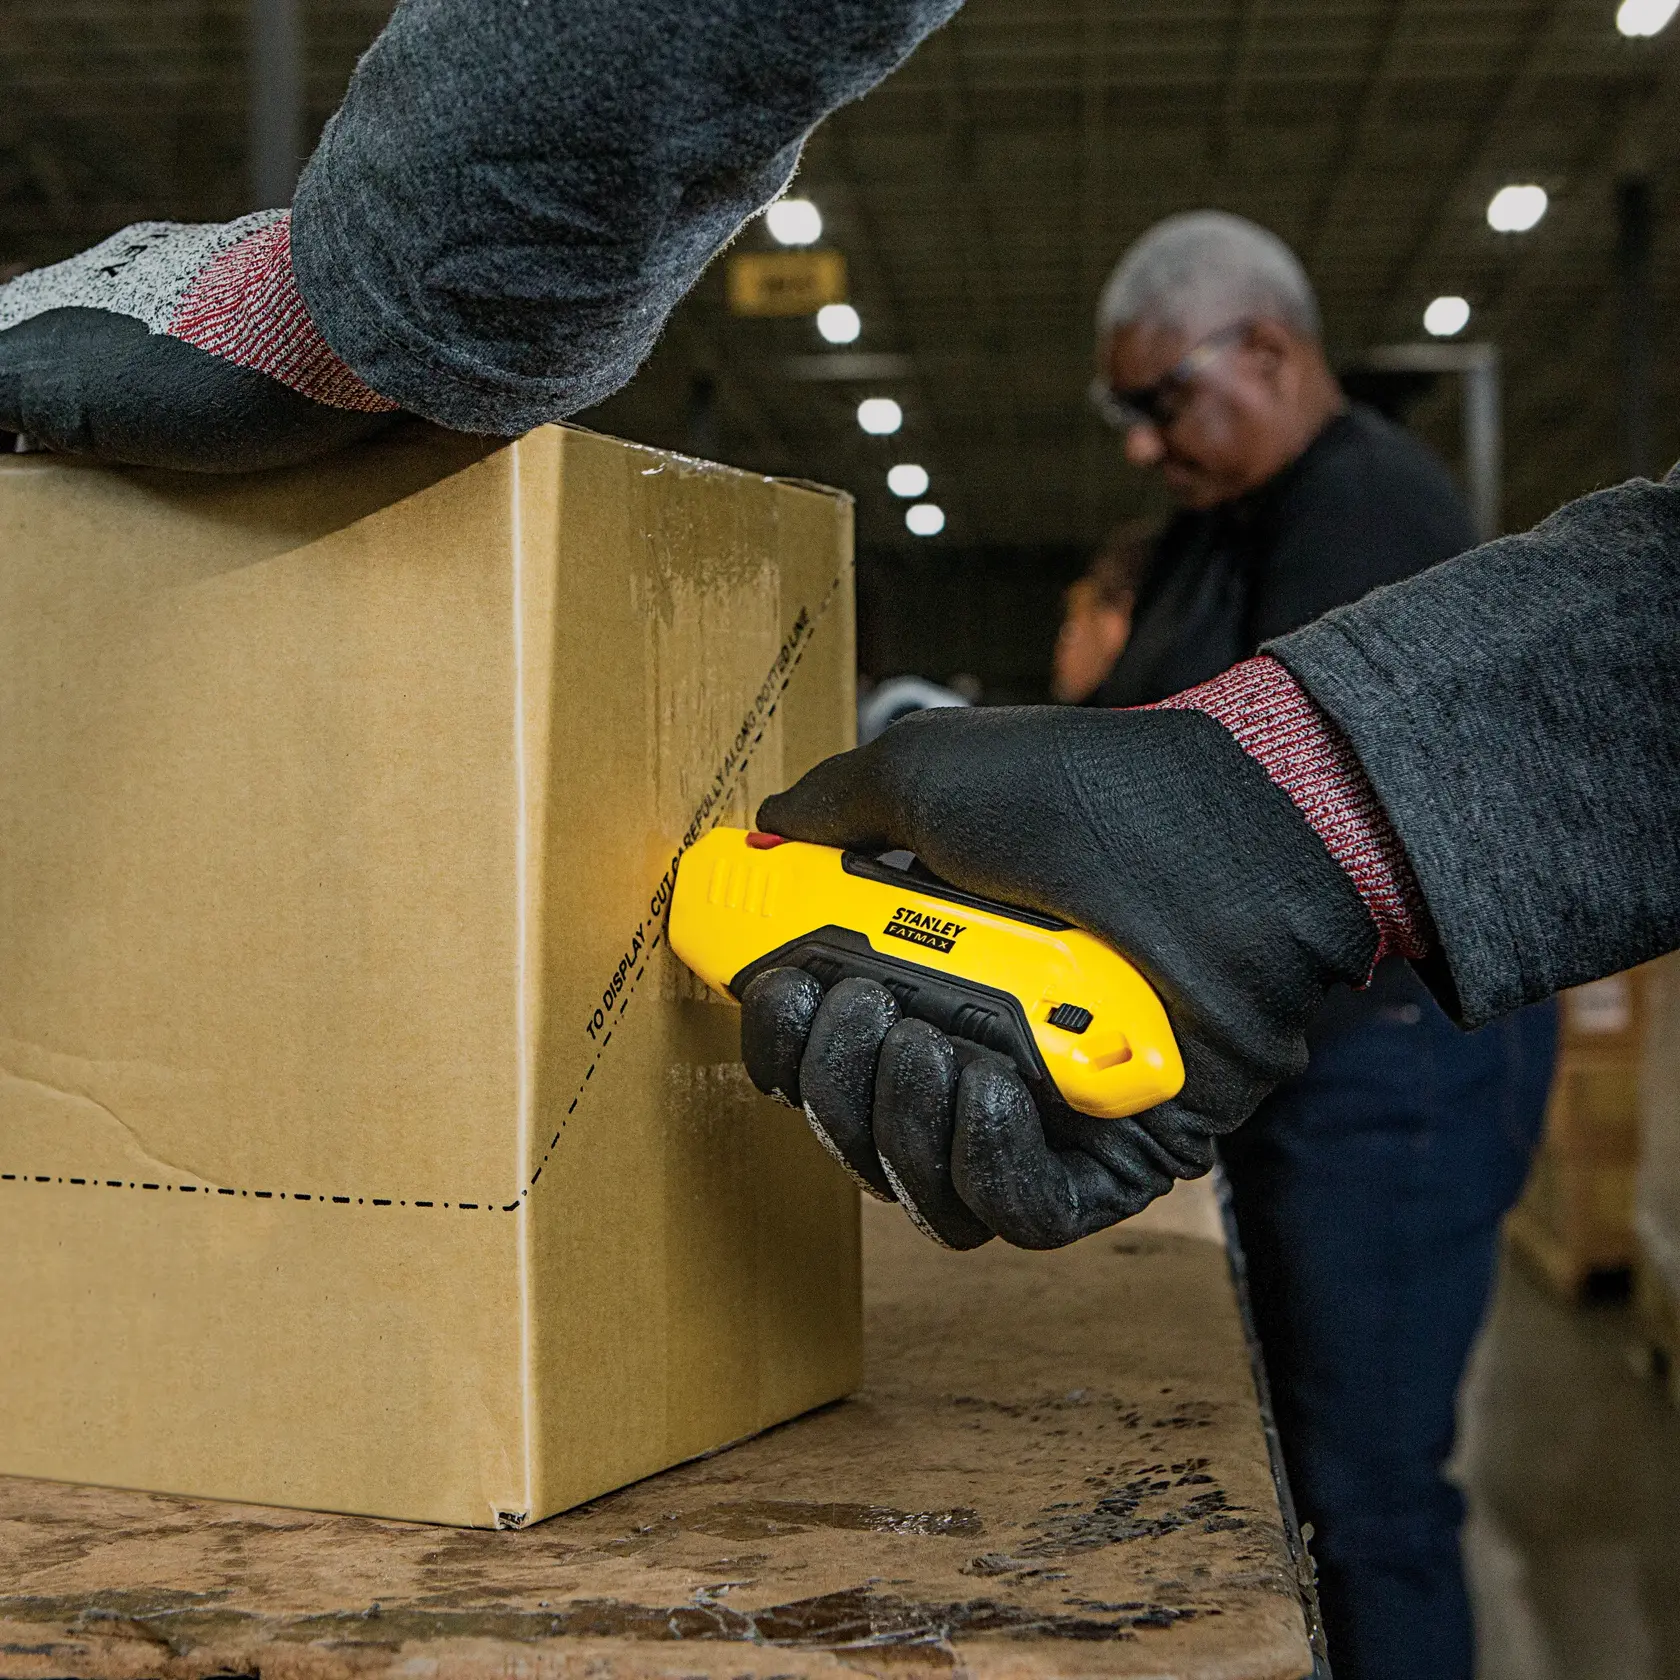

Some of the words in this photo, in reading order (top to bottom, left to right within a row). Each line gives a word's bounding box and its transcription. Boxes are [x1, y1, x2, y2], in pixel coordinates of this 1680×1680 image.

[587, 1009, 604, 1040] TO
[603, 923, 645, 1012] DISPLAY
[650, 871, 674, 916] CUT
[724, 710, 756, 776] ALONG
[889, 925, 949, 949] FATMAX
[892, 907, 967, 938] STANLEY
